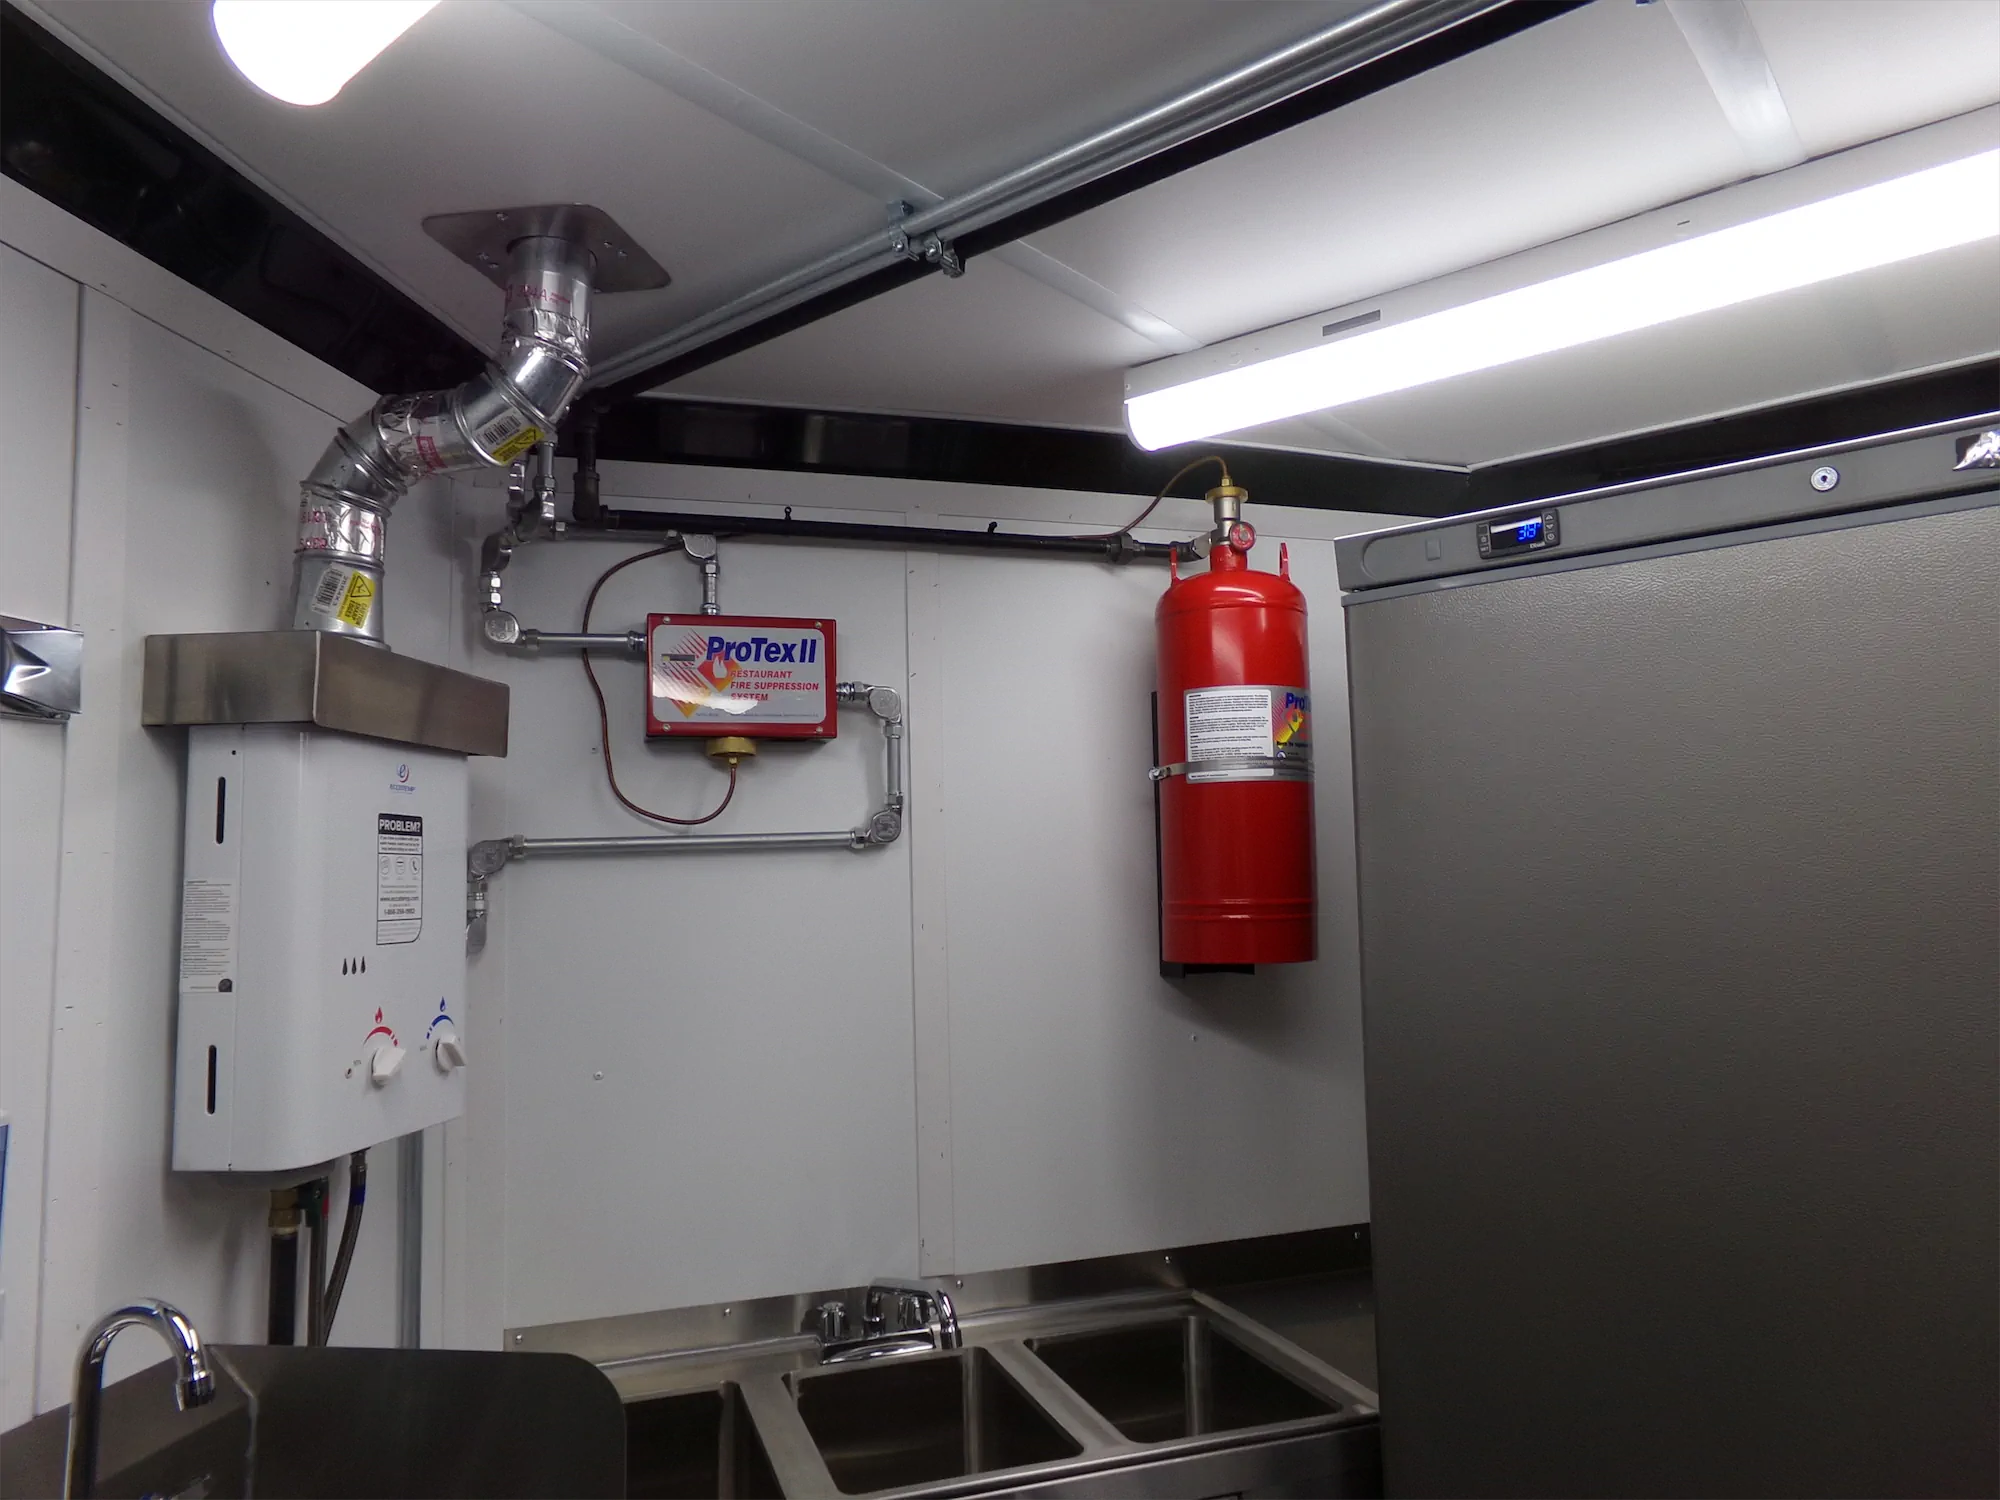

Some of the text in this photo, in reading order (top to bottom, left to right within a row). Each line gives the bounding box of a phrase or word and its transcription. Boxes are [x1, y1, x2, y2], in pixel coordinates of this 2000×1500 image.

[706, 636, 817, 663] ProTex II
[730, 670, 793, 679] RESTAURANT
[730, 682, 819, 691] FIRE SUPPRESSION
[730, 693, 769, 701] SYSTEM
[379, 819, 421, 832] PROBLEM?
